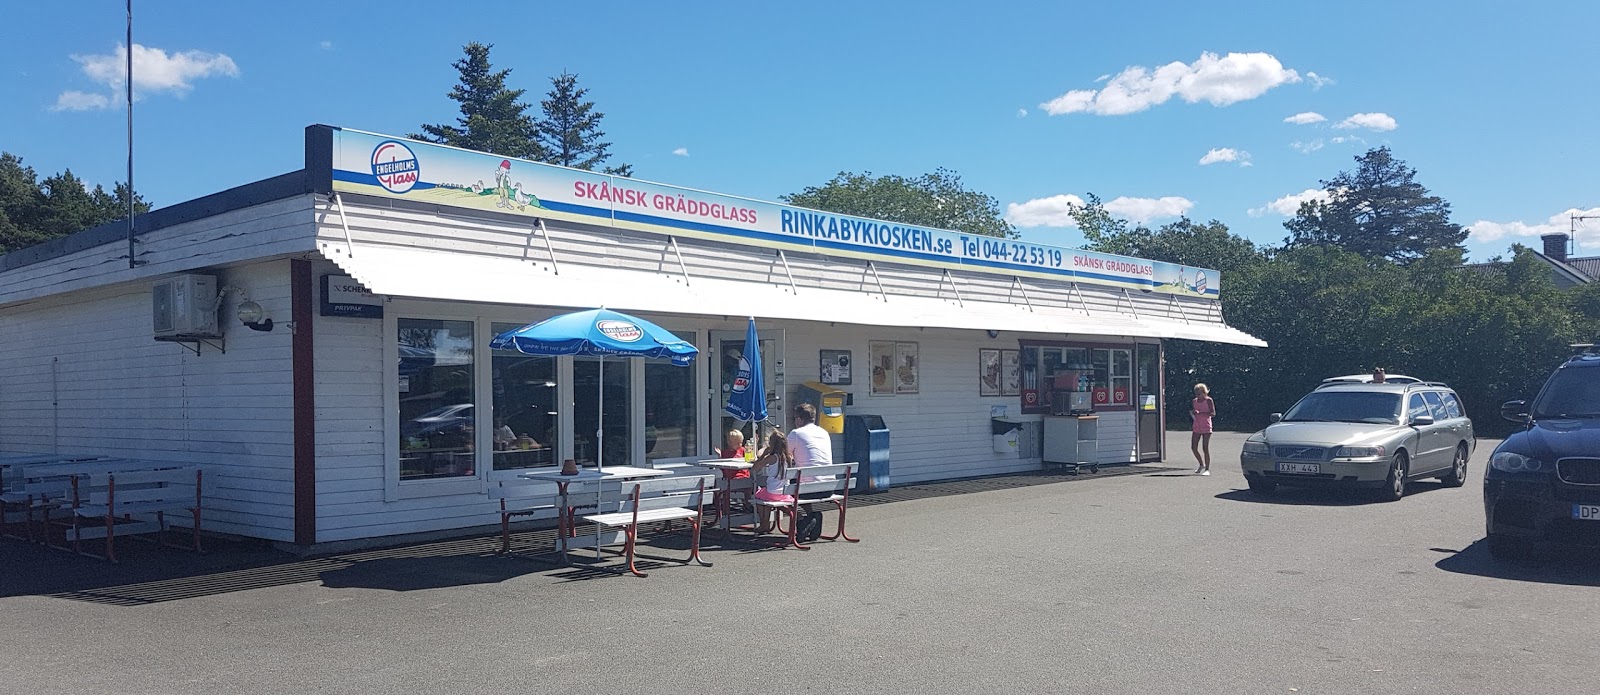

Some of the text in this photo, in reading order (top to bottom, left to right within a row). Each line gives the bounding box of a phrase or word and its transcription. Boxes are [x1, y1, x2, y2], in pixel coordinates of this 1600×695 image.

[376, 160, 415, 175] ENGELHOLMS
[574, 181, 757, 224] SKÅNSK GRÄDDGLASS
[781, 209, 1062, 267] RINKABYKIOSKEN.se Tel 044-22 53 19
[1073, 255, 1152, 276] SKÅNSK GRÄDDGLASS
[342, 285, 373, 294] SCHENK
[1280, 463, 1318, 472] XXH 443
[1581, 506, 1600, 519] DP
